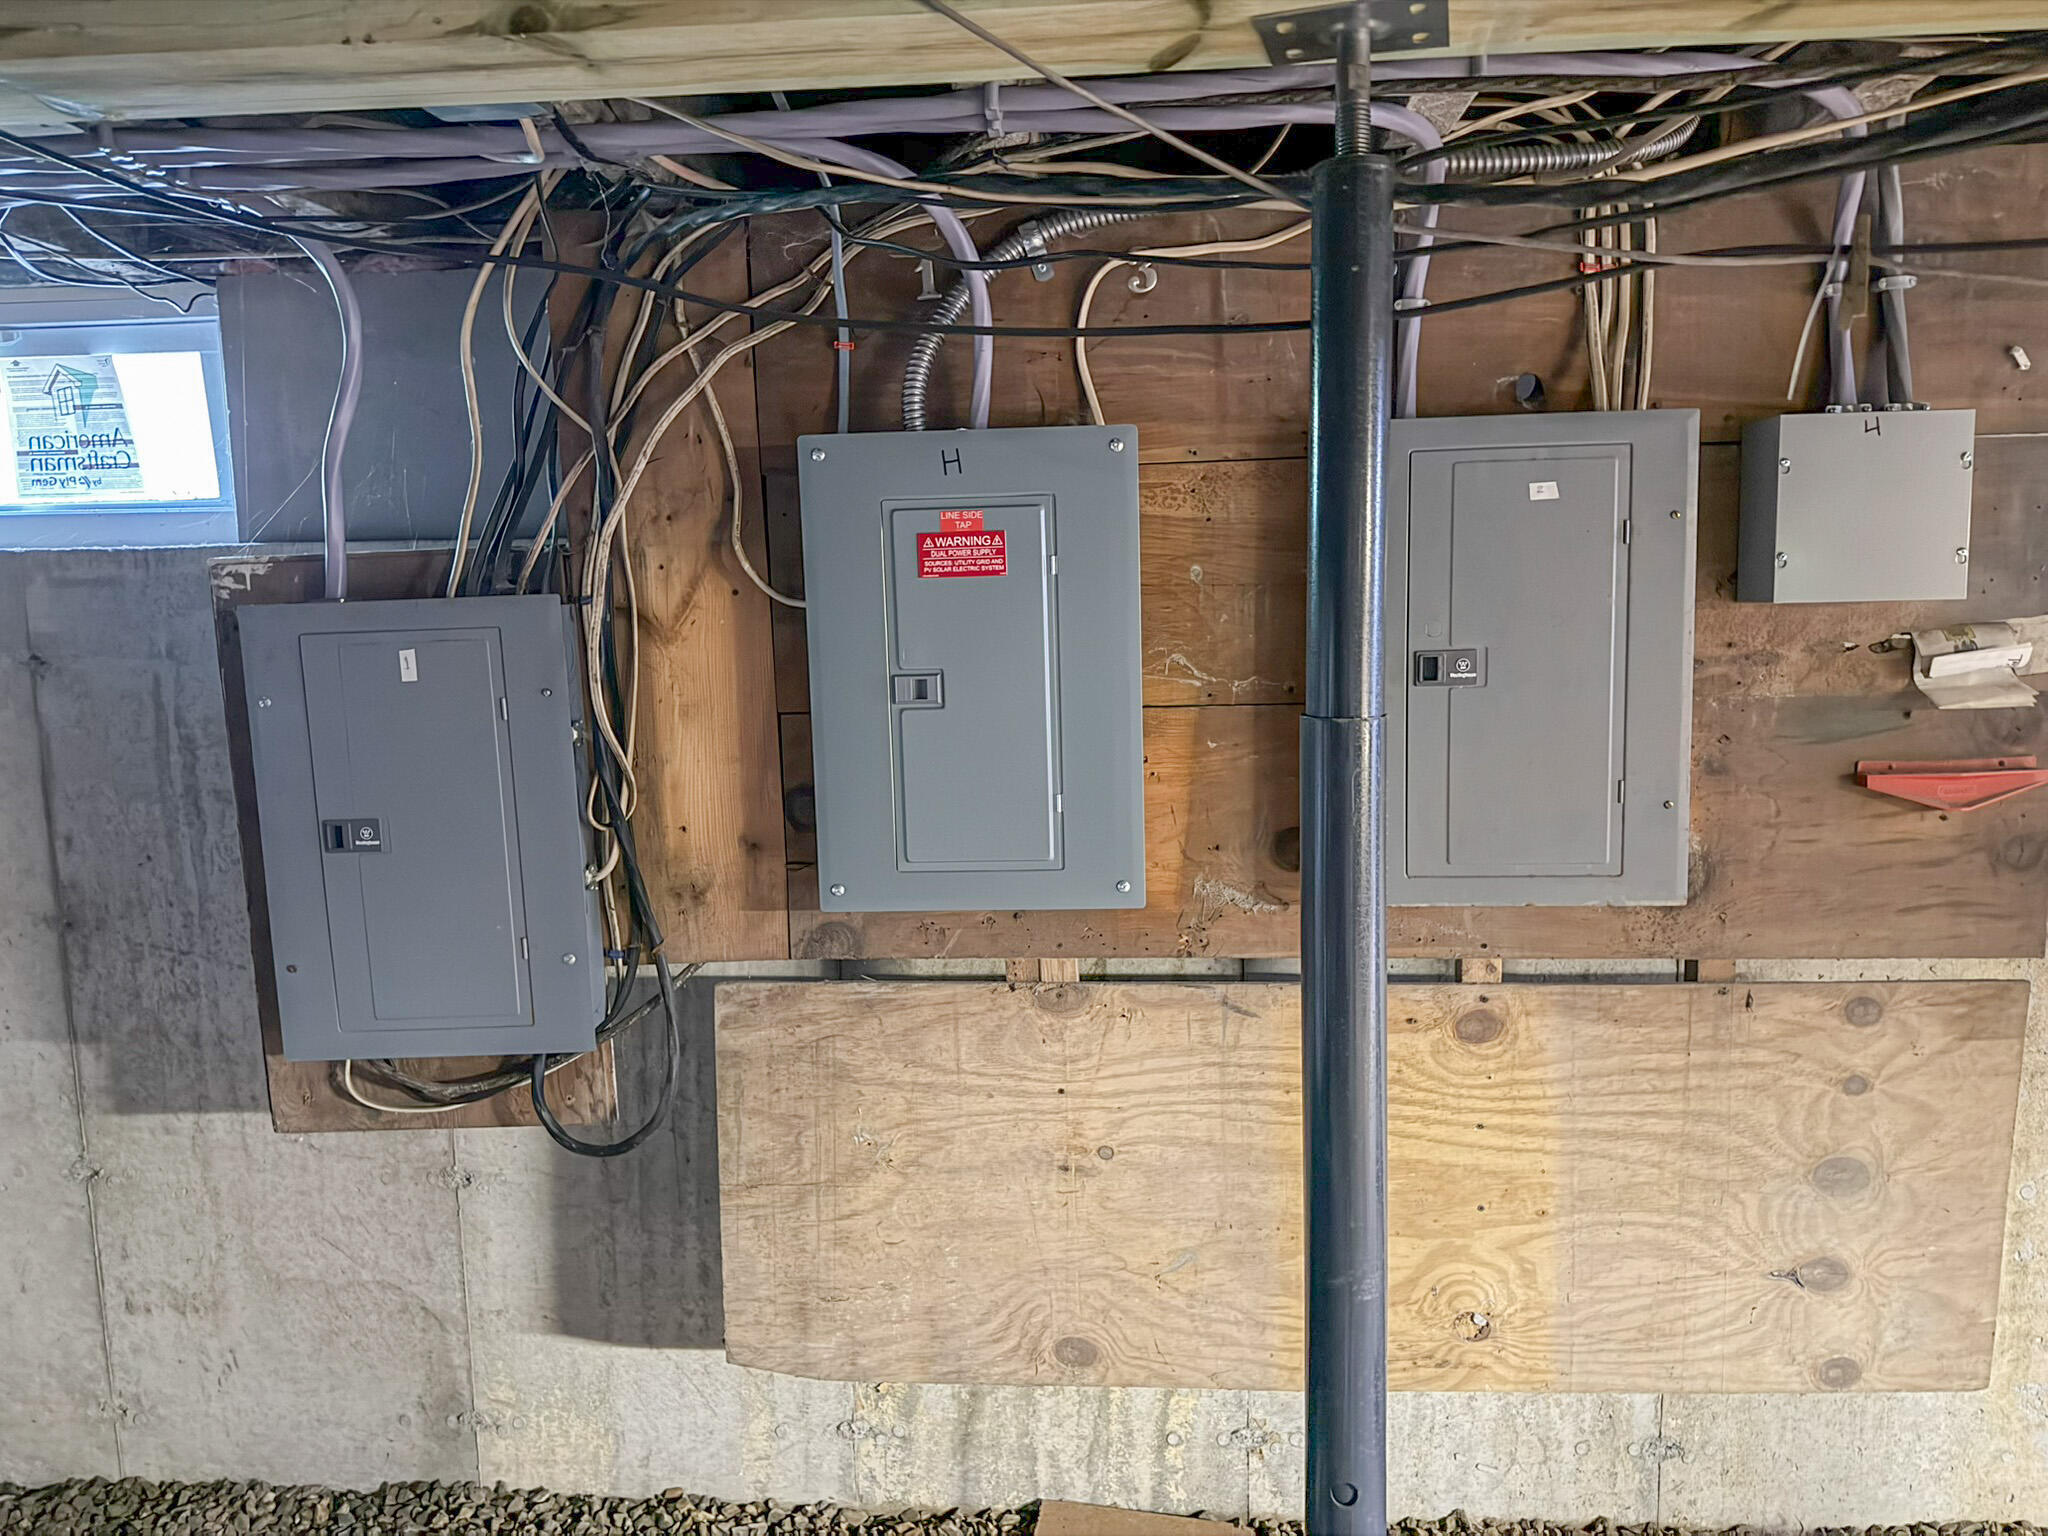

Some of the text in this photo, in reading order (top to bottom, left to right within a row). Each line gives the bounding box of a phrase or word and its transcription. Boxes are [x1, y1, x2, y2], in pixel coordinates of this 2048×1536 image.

[914, 258, 943, 301] 1
[1864, 415, 1881, 436] 4
[940, 510, 983, 520] LINE SIDE
[954, 520, 972, 529] TAP
[934, 535, 991, 547] WARNING
[930, 548, 997, 558] DUAL POWER SUPPLY
